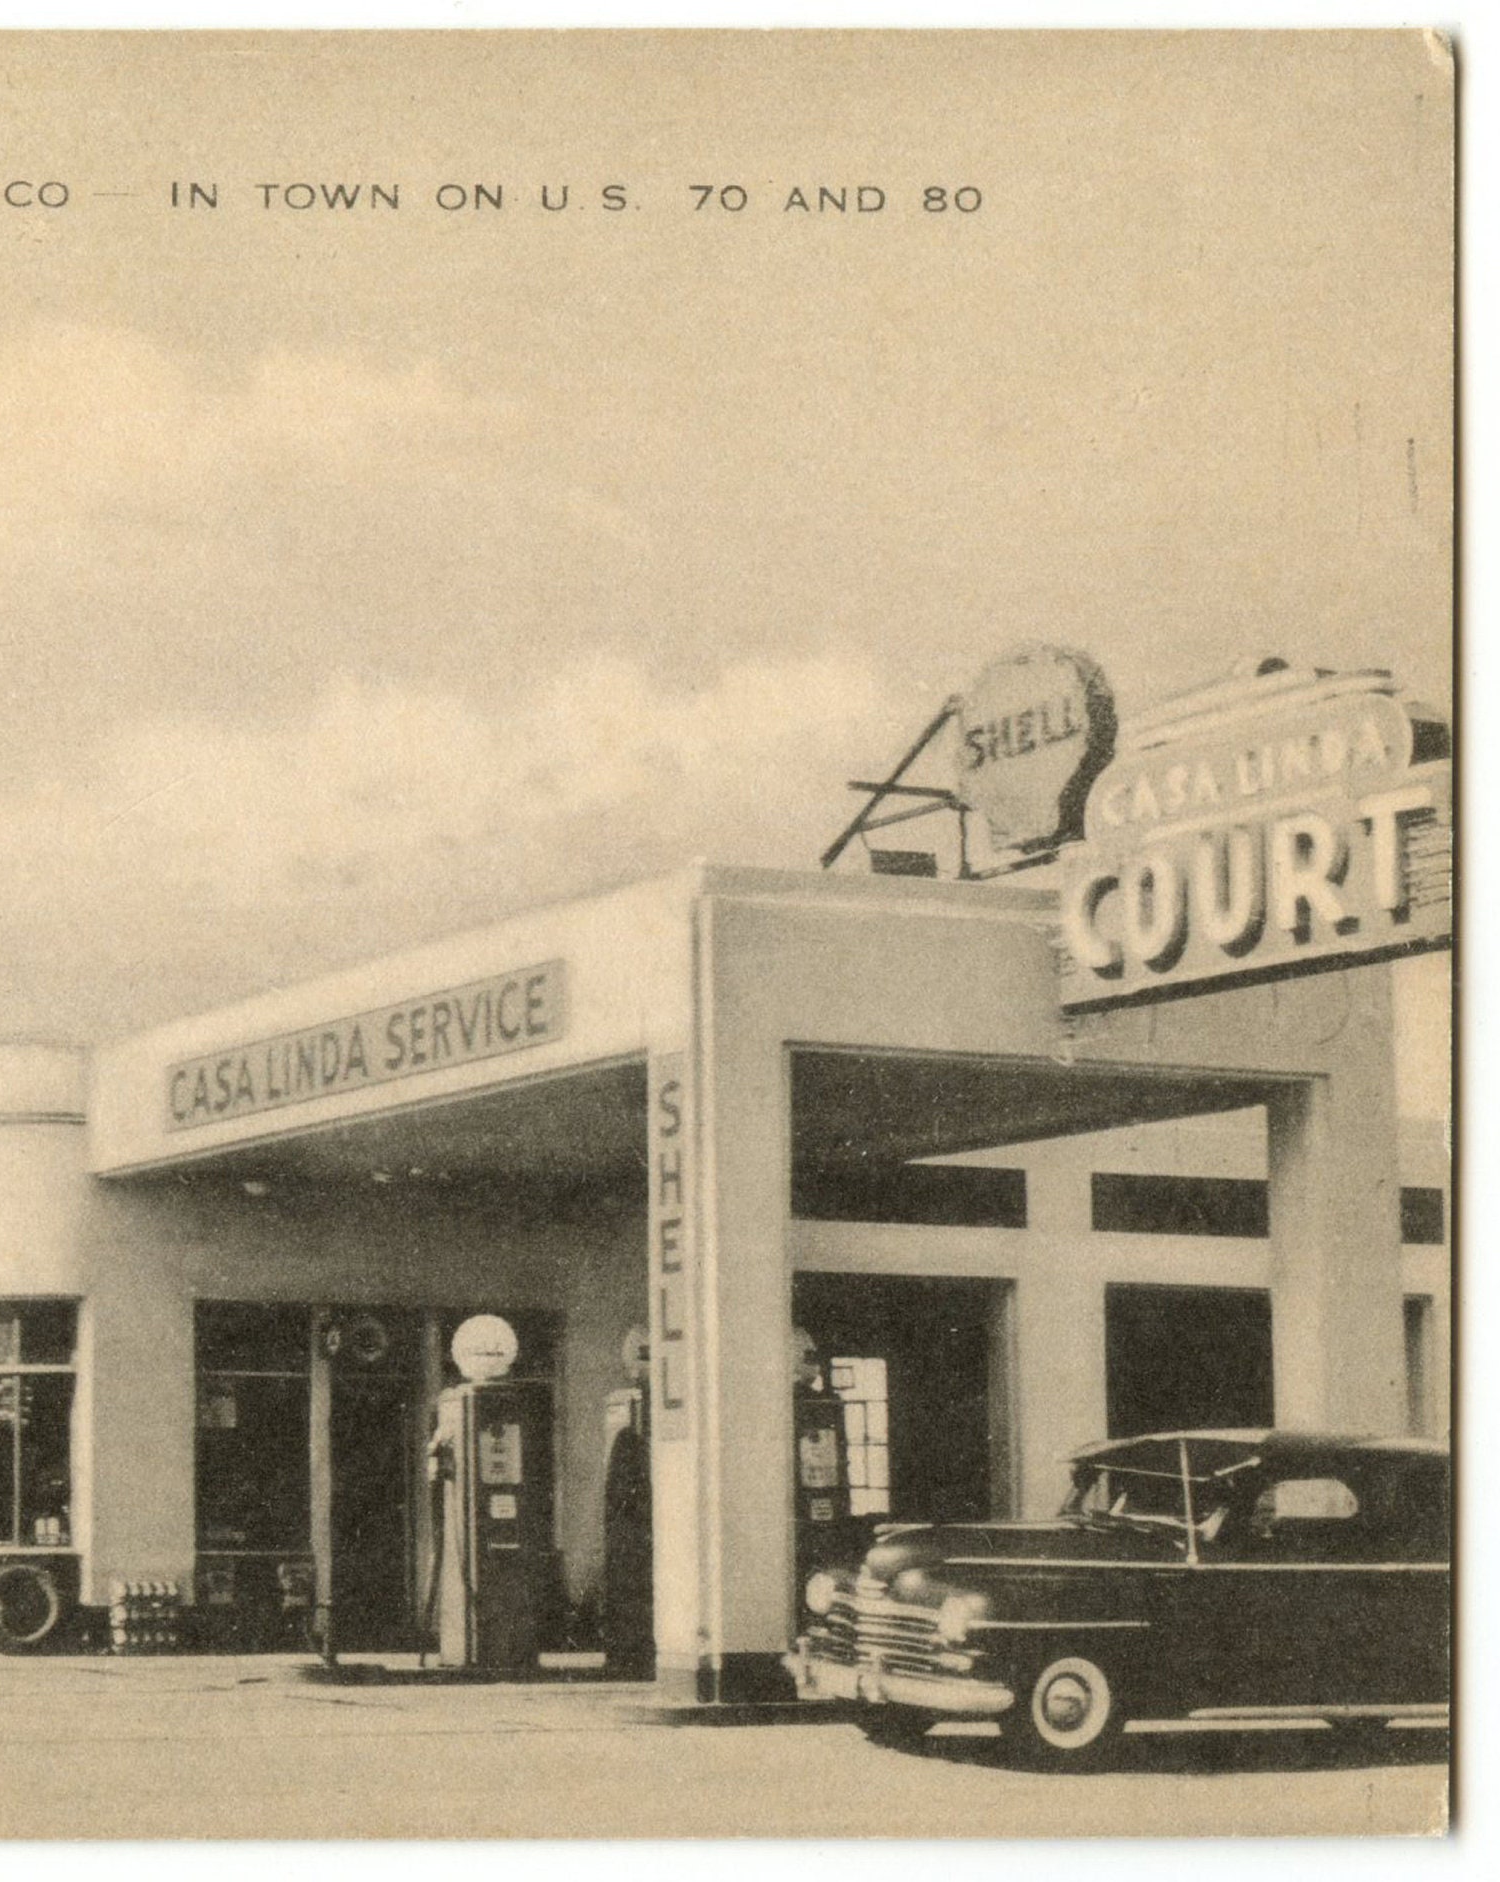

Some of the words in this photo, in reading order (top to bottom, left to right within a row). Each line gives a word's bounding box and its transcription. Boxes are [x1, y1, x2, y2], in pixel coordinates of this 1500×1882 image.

[964, 697, 1081, 770] SHELL
[1101, 759, 1219, 827] CASA
[1236, 721, 1388, 796] LINDA
[1061, 786, 1436, 974] COURT
[168, 1057, 255, 1123] CASA
[266, 1024, 369, 1101] LINDA
[383, 973, 550, 1072] SERVICE
[659, 1079, 684, 1411] SHELL
